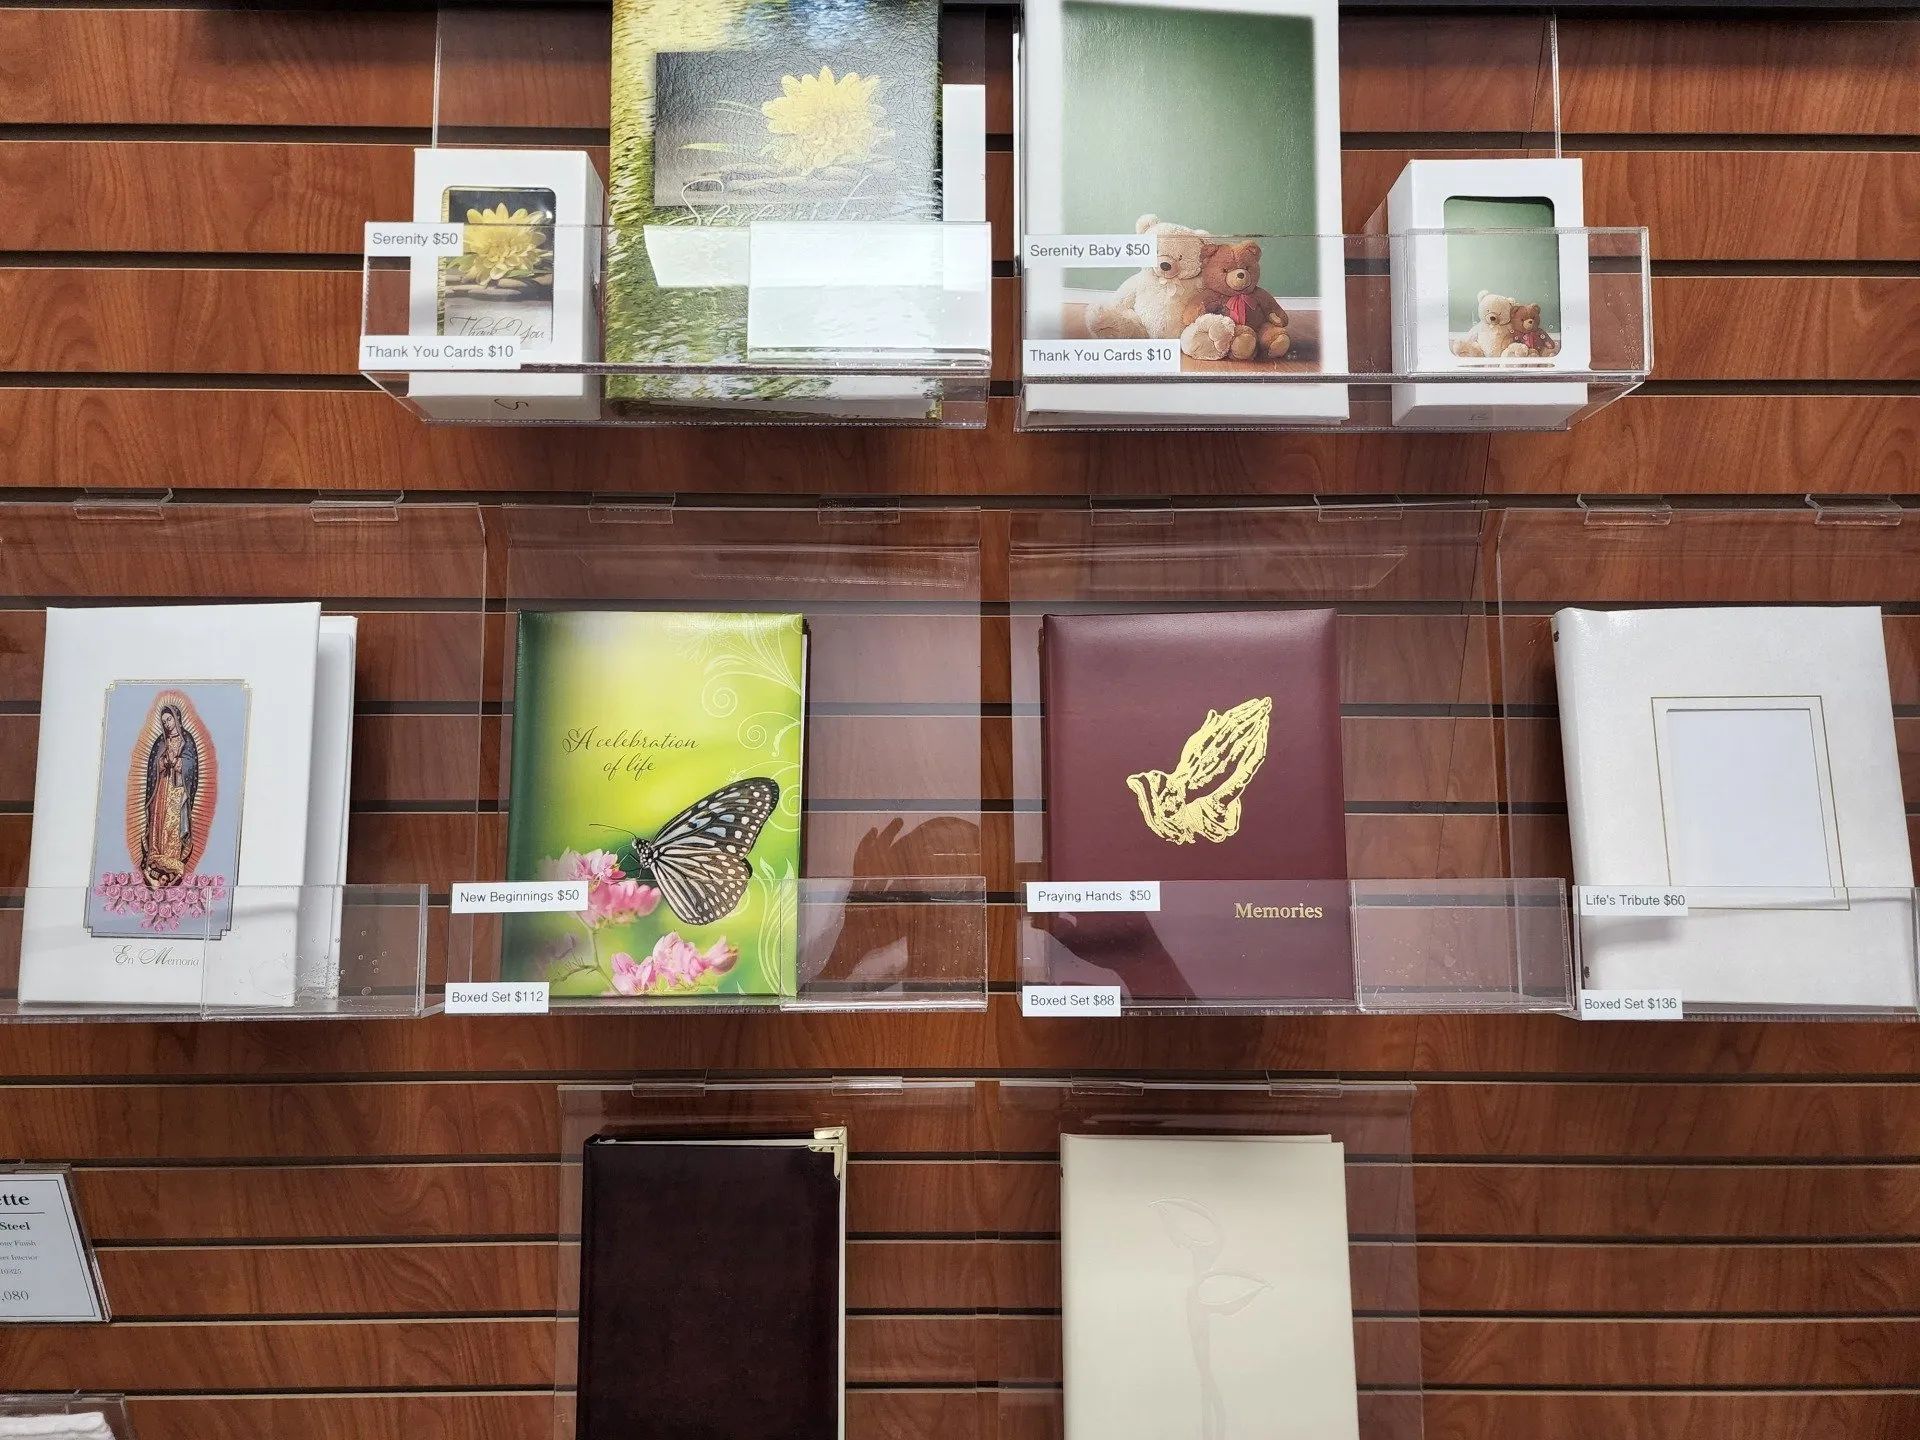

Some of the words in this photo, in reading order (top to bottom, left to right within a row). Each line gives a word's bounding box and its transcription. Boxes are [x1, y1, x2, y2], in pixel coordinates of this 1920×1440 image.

[372, 232, 428, 246] Serenity
[432, 232, 459, 246] $50
[1030, 244, 1085, 258] Serenity
[1089, 243, 1122, 257] Baby
[1125, 243, 1150, 257] $50
[365, 345, 409, 358] Thank
[413, 345, 439, 358] You
[443, 345, 484, 358] Cards
[488, 344, 514, 358] $10
[1030, 349, 1071, 362] Thank
[1074, 349, 1100, 362] You
[1103, 348, 1143, 361] Cards
[1146, 347, 1172, 362] $10
[562, 725, 599, 753] A
[596, 729, 700, 750] celebration
[603, 754, 627, 781] of
[626, 752, 656, 781] life
[460, 891, 487, 903] New
[490, 890, 554, 904] Beginnings
[557, 889, 580, 901] $50
[1038, 890, 1082, 903] Praying
[1086, 890, 1123, 901] Hands
[1129, 889, 1152, 902] $50
[1586, 894, 1616, 906] Life's
[1619, 894, 1661, 906] Tribute
[1663, 894, 1686, 907] $60
[1233, 902, 1323, 919] Memories
[112, 944, 134, 965] En
[139, 946, 200, 966] Memoria
[452, 991, 488, 1003] Boxed
[492, 991, 511, 1003] Set
[514, 990, 544, 1003] $112
[1030, 994, 1067, 1006] Boxed
[1070, 994, 1090, 1006] Set
[1093, 994, 1115, 1007] $88
[1584, 998, 1621, 1010] Boxed
[1624, 997, 1645, 1010] Set
[1647, 997, 1677, 1010] $136
[0, 1221, 31, 1231] Steel
